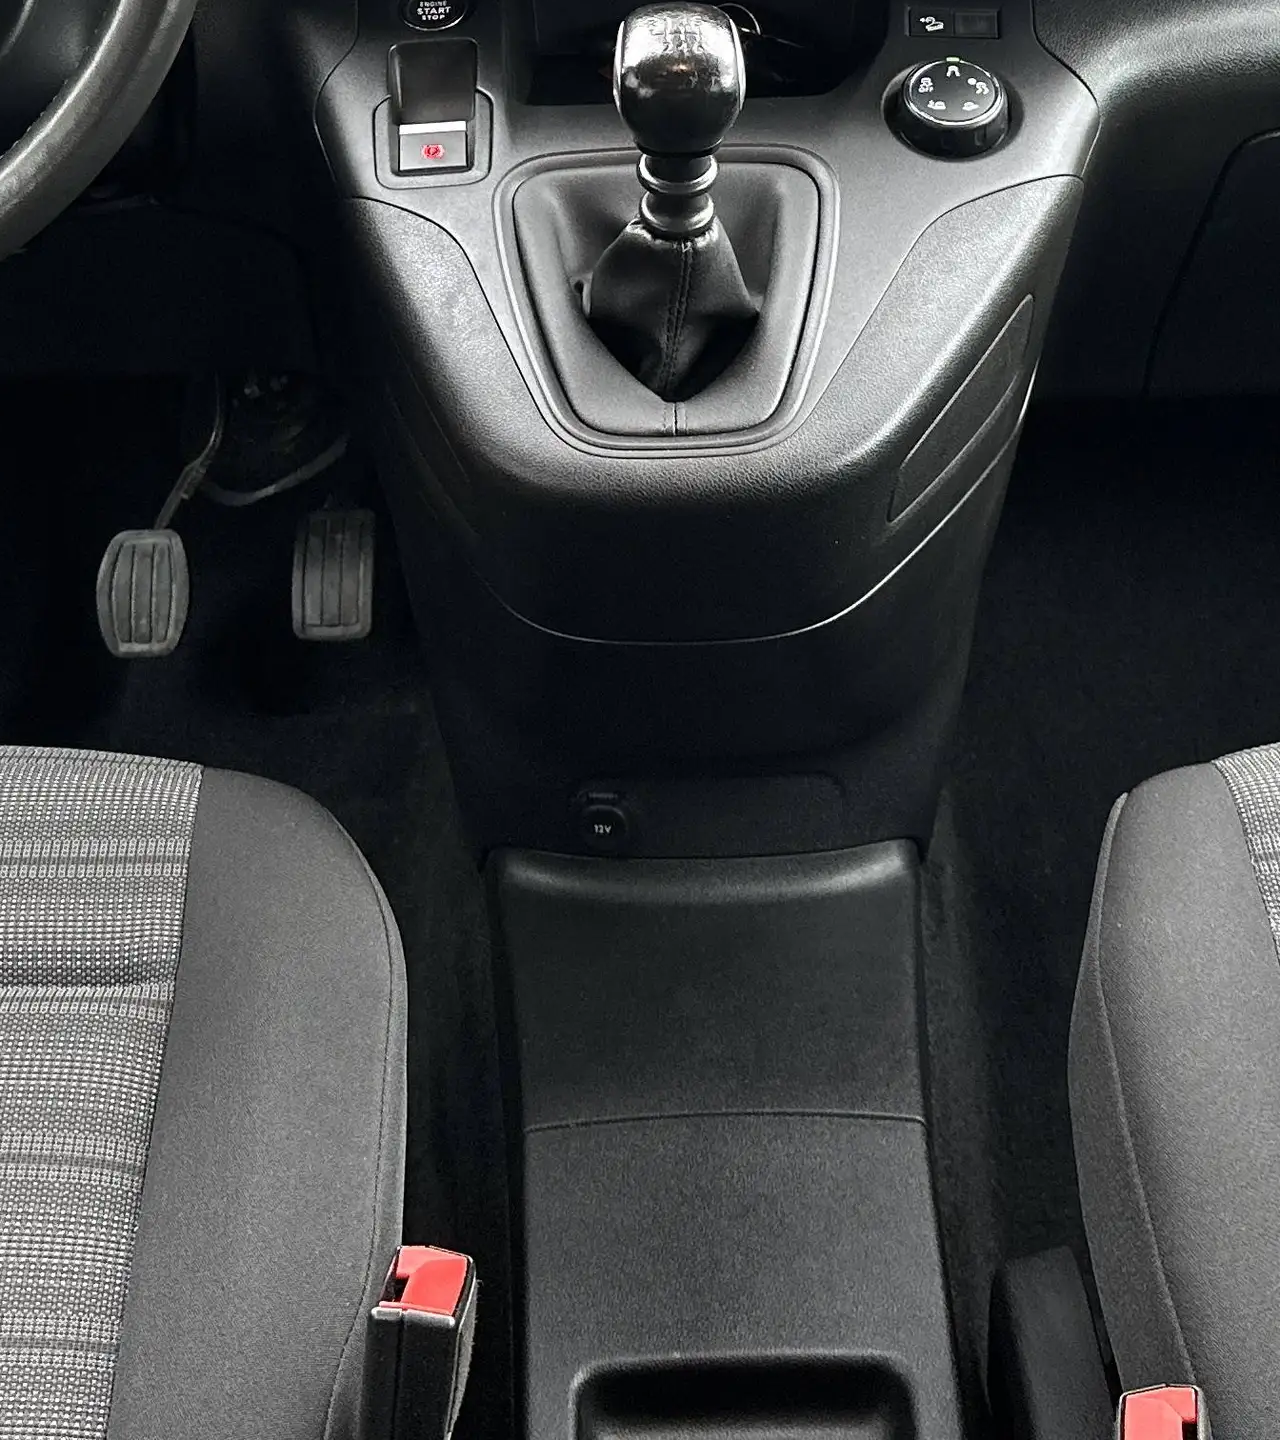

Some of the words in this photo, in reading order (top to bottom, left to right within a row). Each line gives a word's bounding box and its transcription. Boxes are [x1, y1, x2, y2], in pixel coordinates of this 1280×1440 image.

[419, 0, 448, 8] ENGINE
[416, 6, 452, 16] START
[594, 824, 612, 834] 12V
